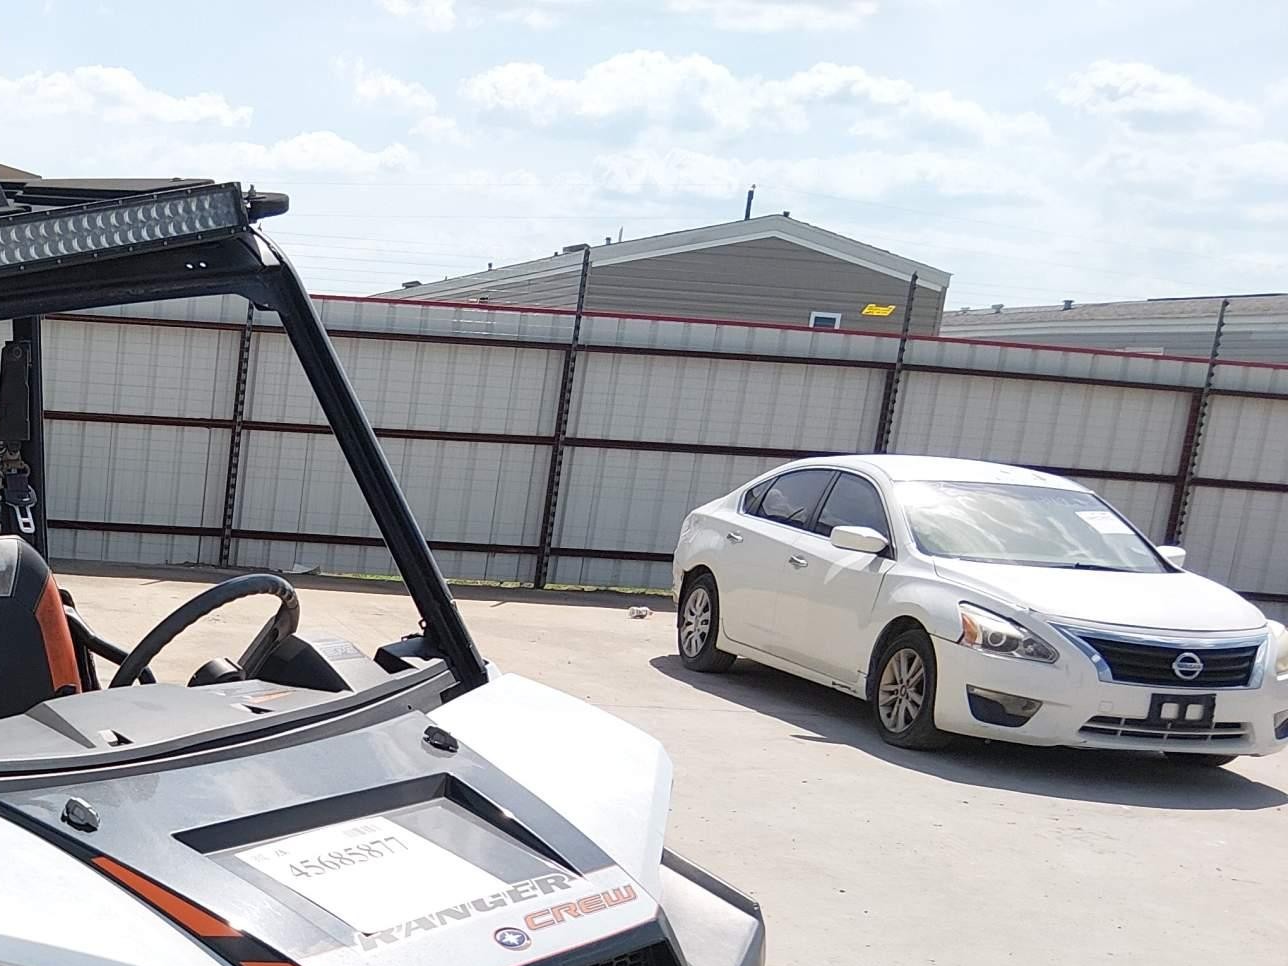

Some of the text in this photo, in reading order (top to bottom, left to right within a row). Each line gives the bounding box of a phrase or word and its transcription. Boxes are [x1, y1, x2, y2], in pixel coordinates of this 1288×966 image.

[288, 836, 409, 878] 45685877
[358, 873, 578, 951] RANGER
[524, 884, 638, 931] CREW
